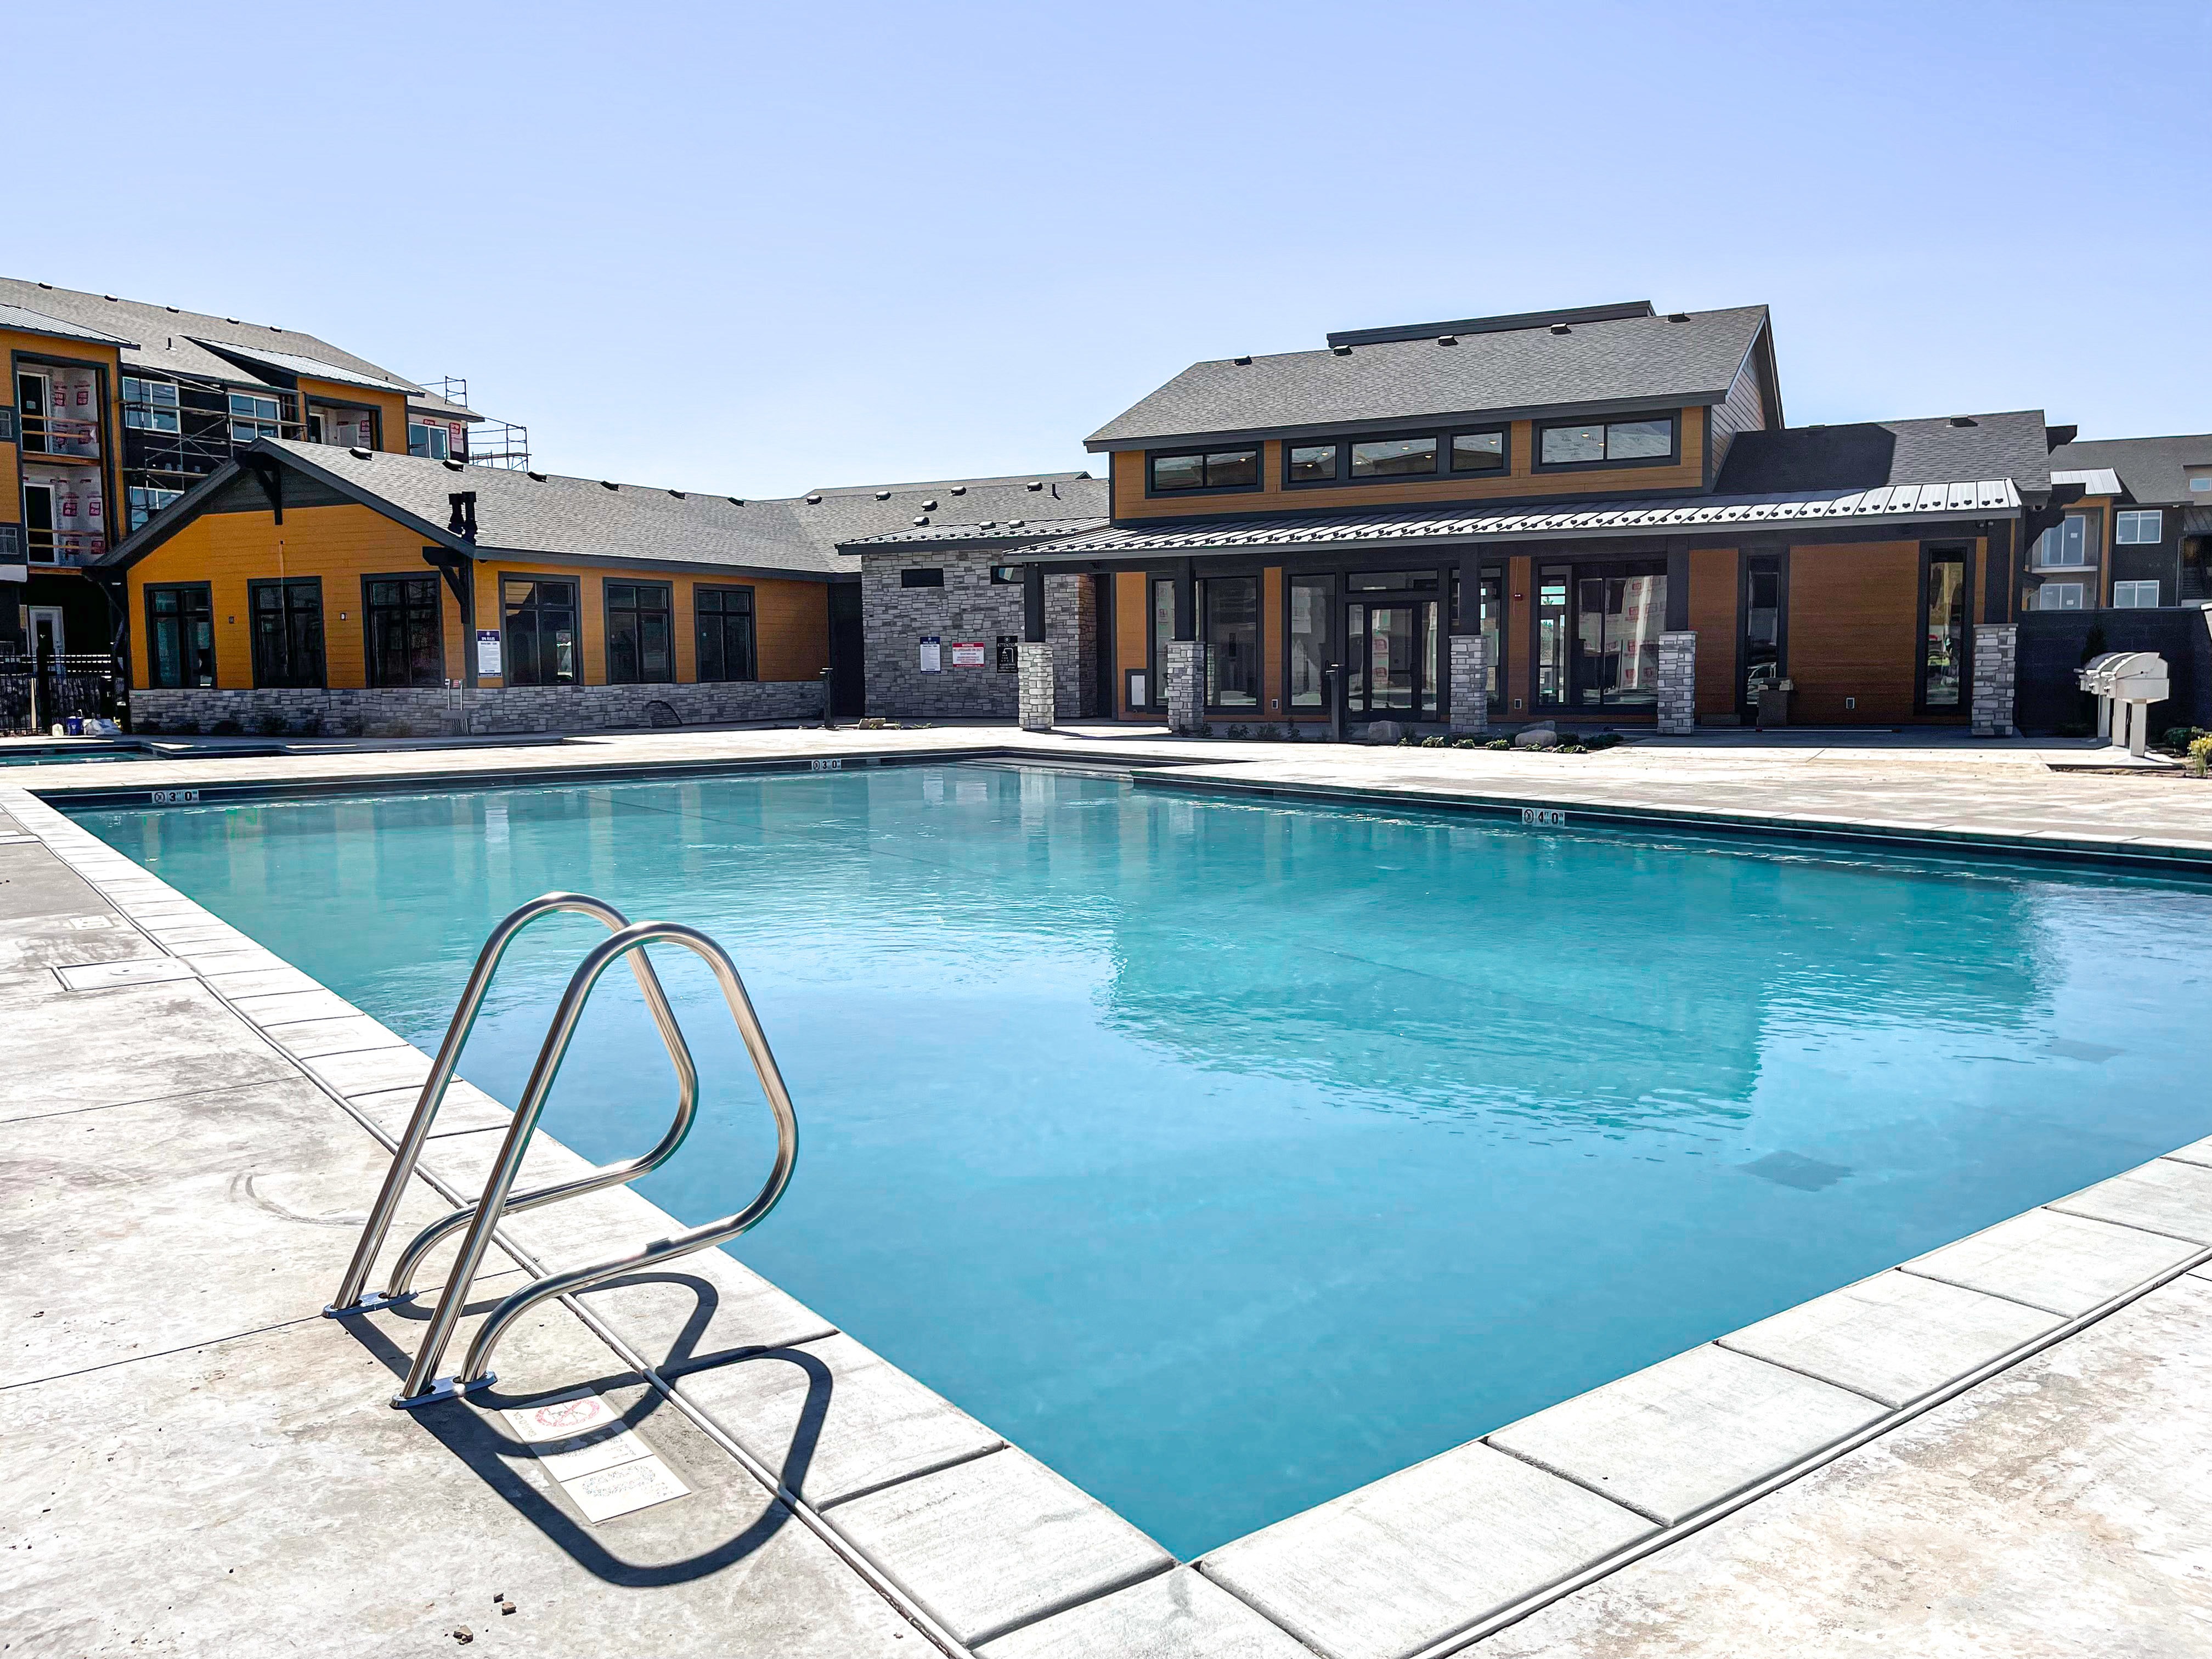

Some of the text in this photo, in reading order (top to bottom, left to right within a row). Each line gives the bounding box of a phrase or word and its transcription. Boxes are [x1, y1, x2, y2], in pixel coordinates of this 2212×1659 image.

[822, 760, 827, 769] 3
[832, 760, 837, 769] 0
[169, 792, 176, 802] 3
[184, 791, 193, 801] 0
[1551, 812, 1559, 823] 0
